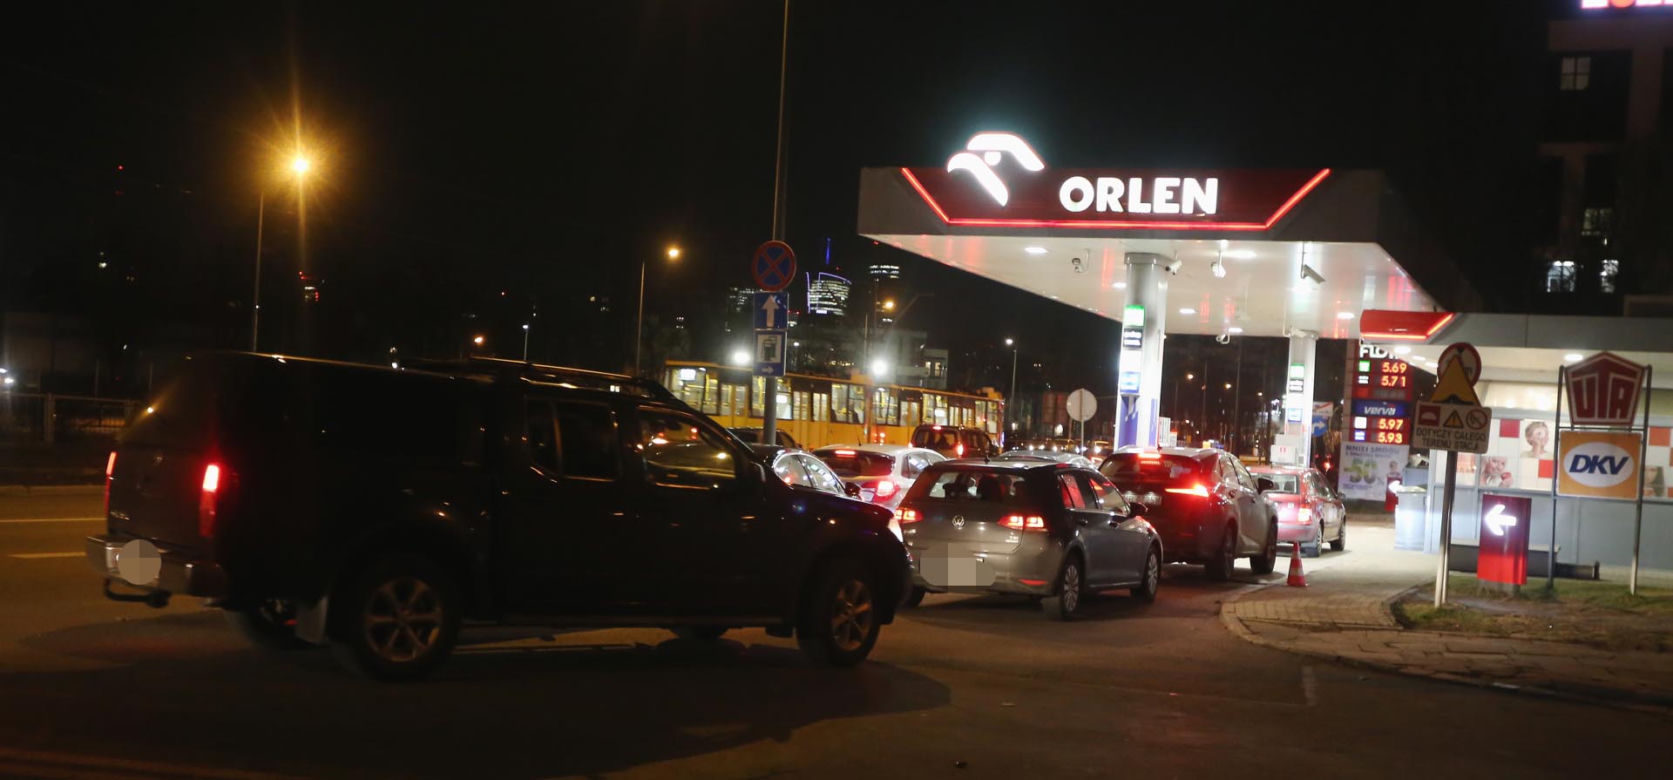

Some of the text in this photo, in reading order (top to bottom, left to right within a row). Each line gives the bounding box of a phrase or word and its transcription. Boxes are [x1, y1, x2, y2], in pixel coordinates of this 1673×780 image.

[1059, 176, 1218, 214] ORLEN
[1382, 362, 1407, 373] 5.69
[1381, 376, 1406, 387] 5.71
[1568, 357, 1640, 419] UTA
[1378, 418, 1404, 430] 5.97
[1378, 432, 1403, 443] 5.93
[1569, 454, 1630, 475] DKV
